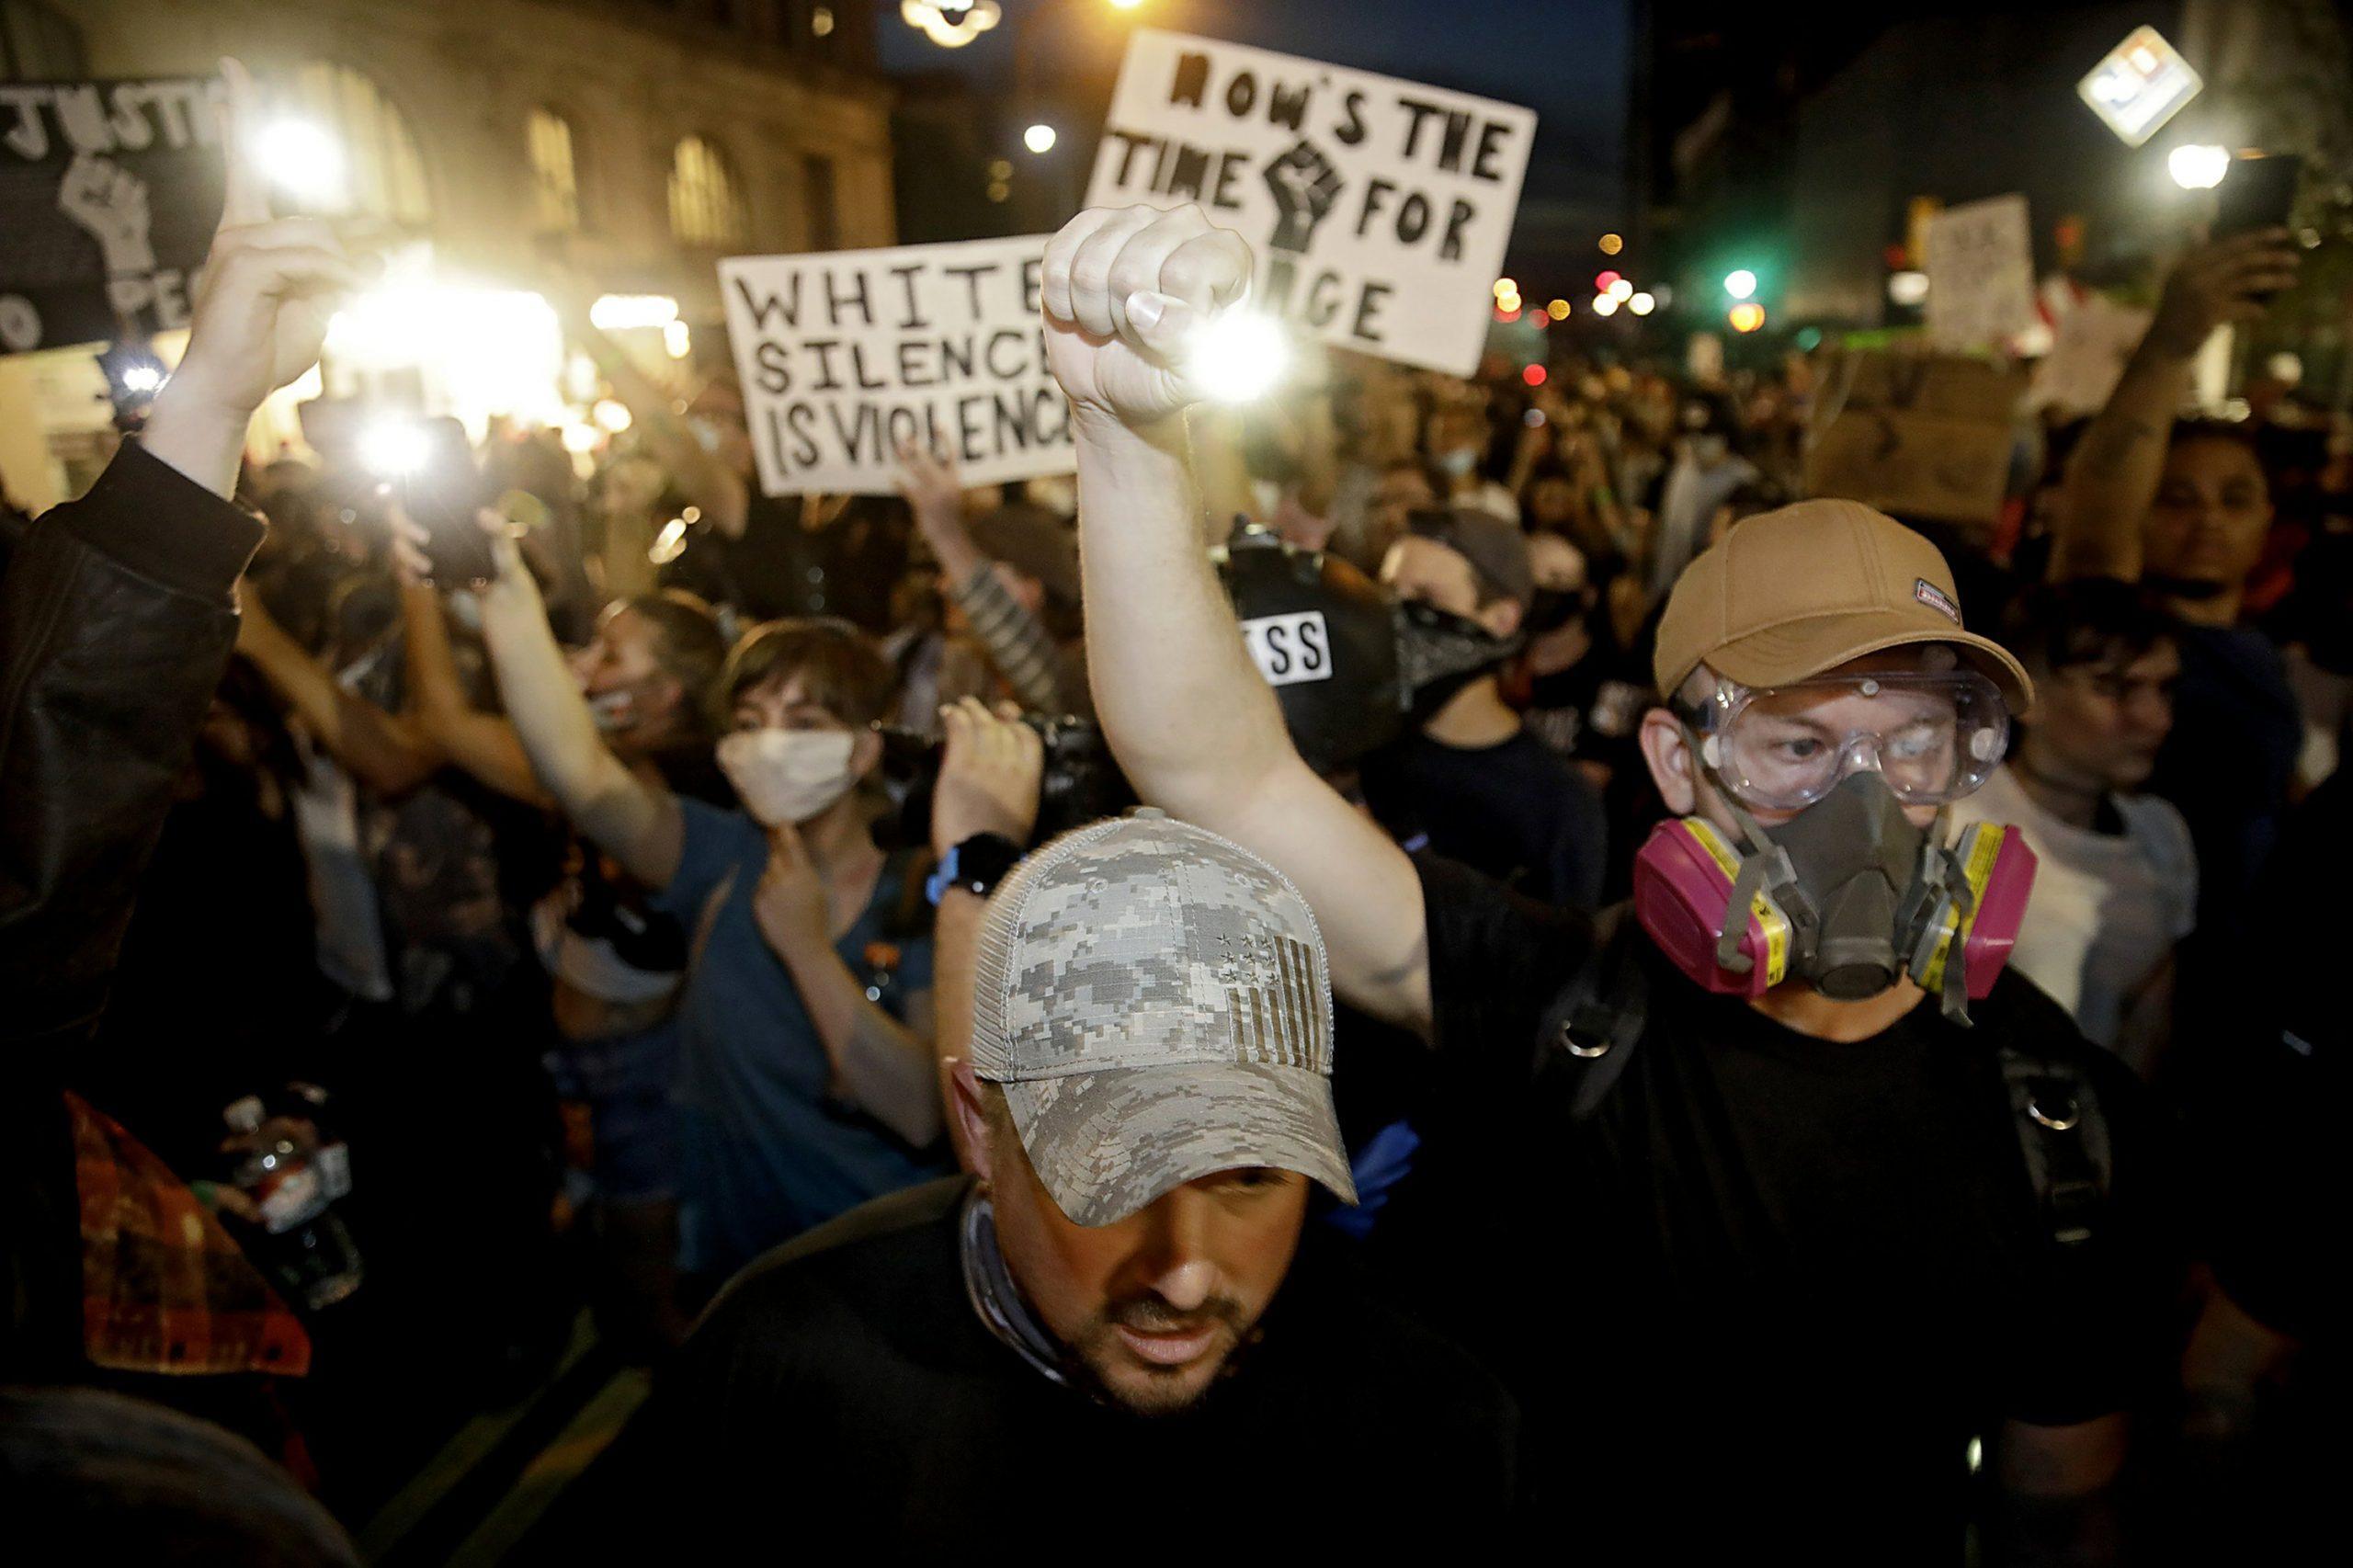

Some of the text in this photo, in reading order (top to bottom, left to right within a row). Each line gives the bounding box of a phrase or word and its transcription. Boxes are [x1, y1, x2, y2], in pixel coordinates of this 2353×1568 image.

[1169, 51, 1513, 183] NOW'S THE
[1108, 129, 1476, 262] TIME FOR
[755, 328, 1055, 395] SILENC
[767, 388, 1074, 478] IS VIOLENC
[1243, 621, 1322, 675] SS
